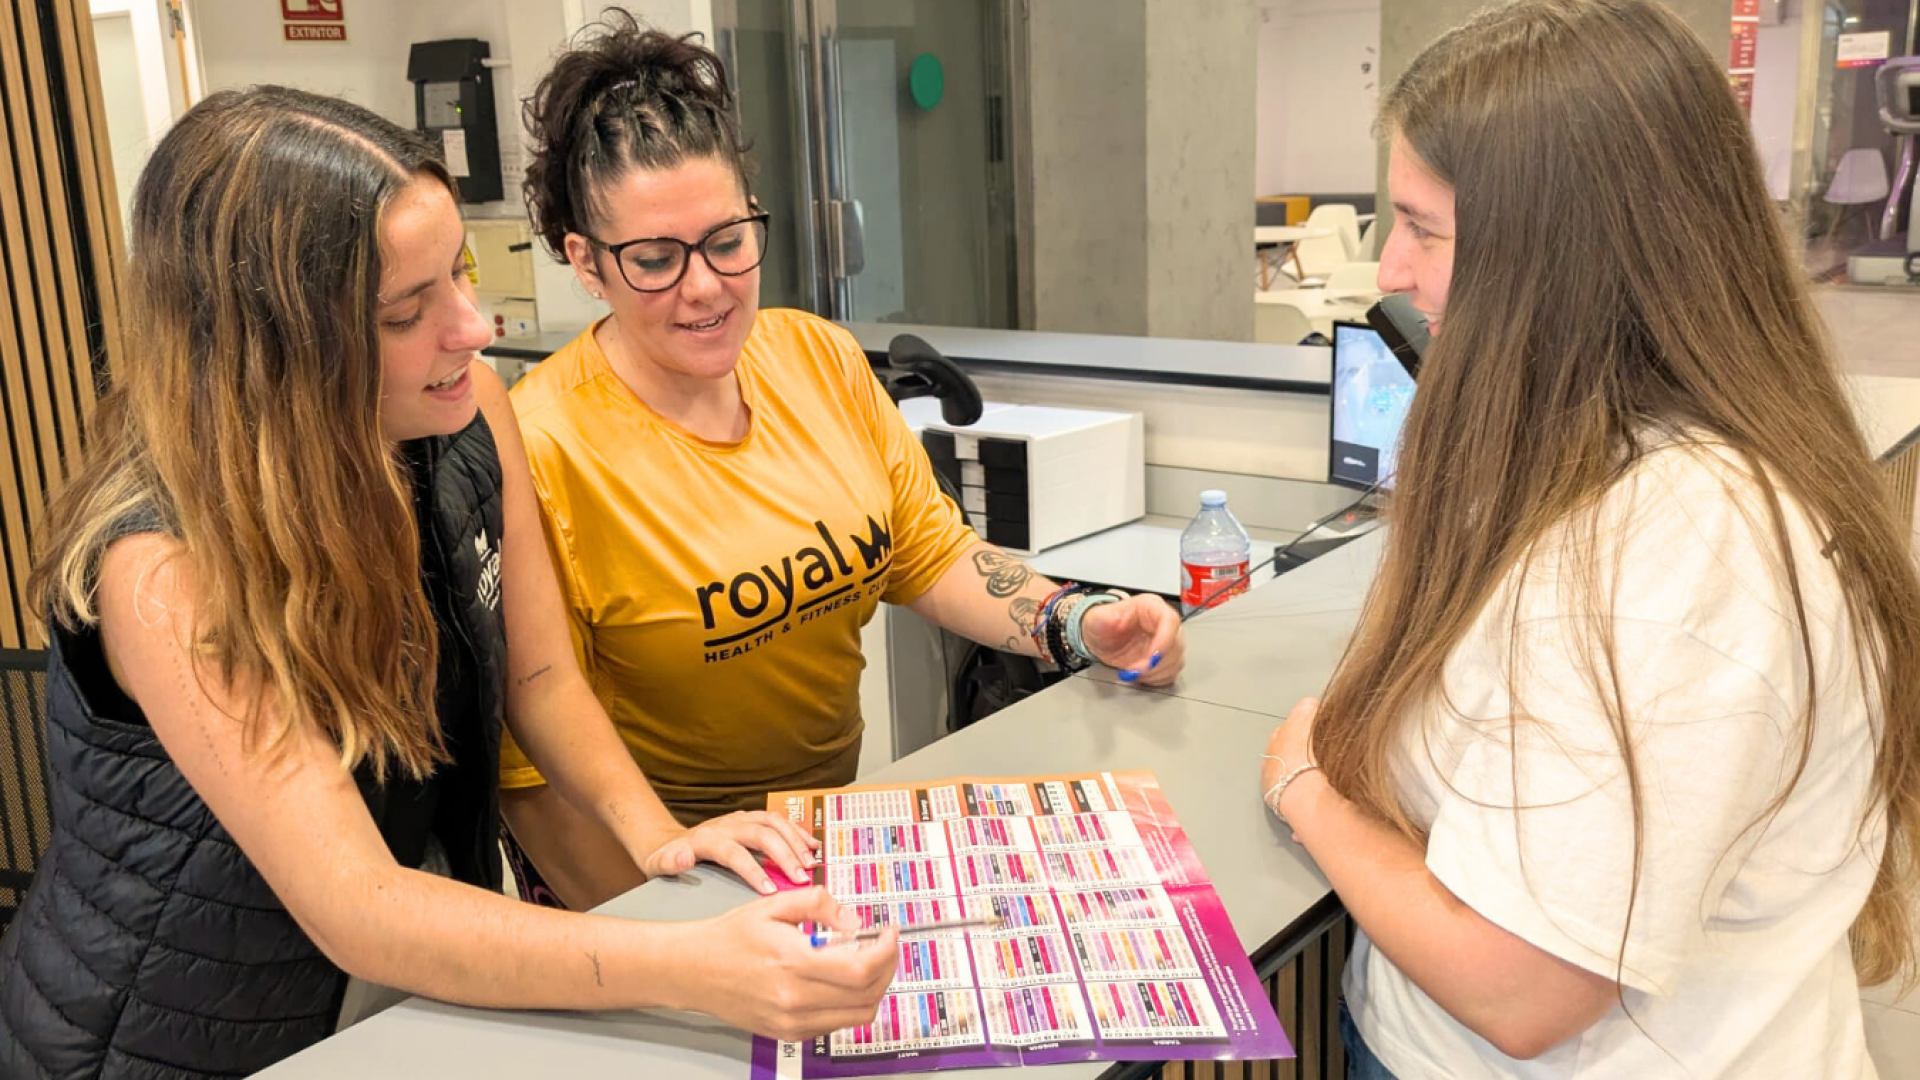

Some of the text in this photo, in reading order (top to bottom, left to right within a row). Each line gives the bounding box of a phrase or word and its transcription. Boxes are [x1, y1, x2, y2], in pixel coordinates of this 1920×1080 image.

[288, 25, 342, 38] EXTINTOR
[696, 520, 854, 629] royal
[704, 630, 774, 663] HEALTH
[781, 622, 792, 633] &
[800, 591, 861, 626] FITNESS
